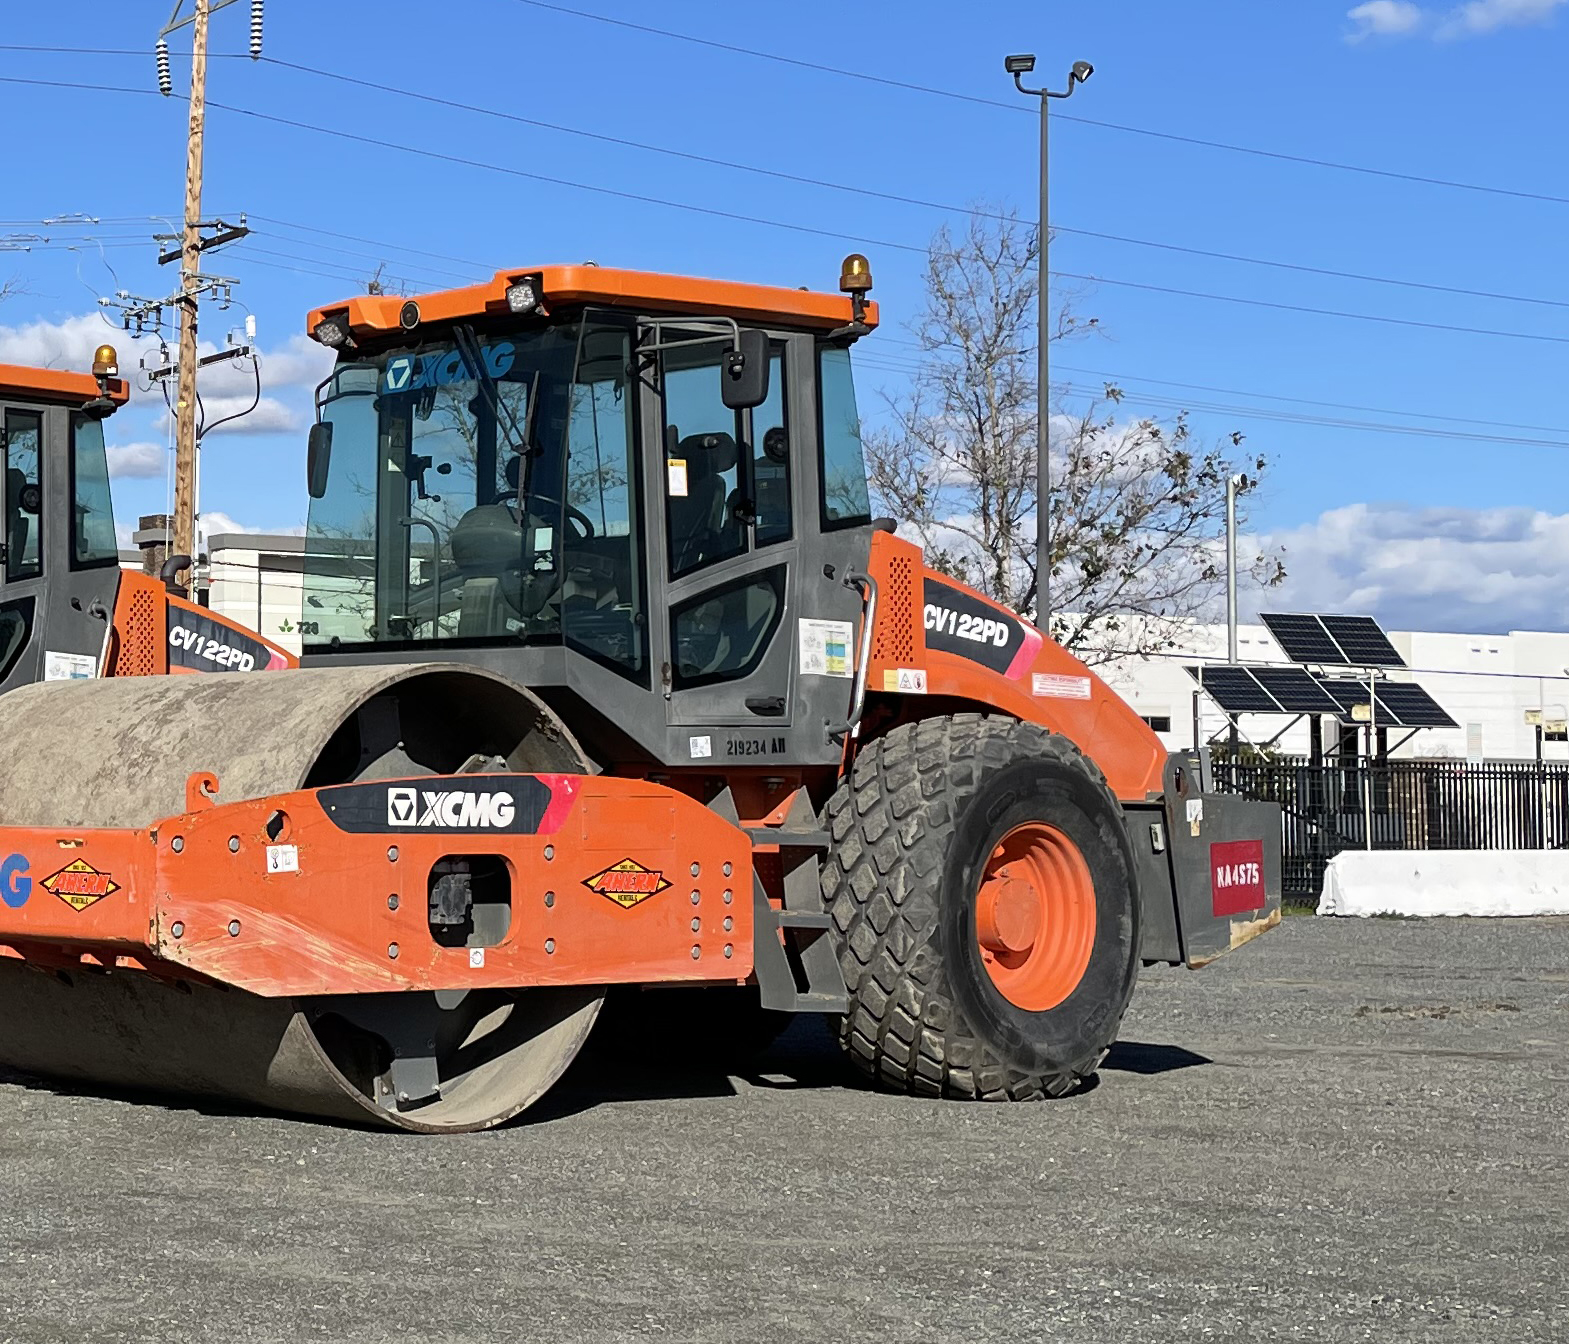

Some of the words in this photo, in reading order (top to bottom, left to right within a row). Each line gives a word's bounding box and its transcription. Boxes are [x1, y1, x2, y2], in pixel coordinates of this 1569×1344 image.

[923, 604, 1010, 648] CV122PD
[168, 625, 255, 672] CV122PD
[726, 739, 767, 756] 219234
[416, 790, 516, 828] XCMG
[49, 871, 111, 896] AHERN
[593, 870, 662, 893] AHERN
